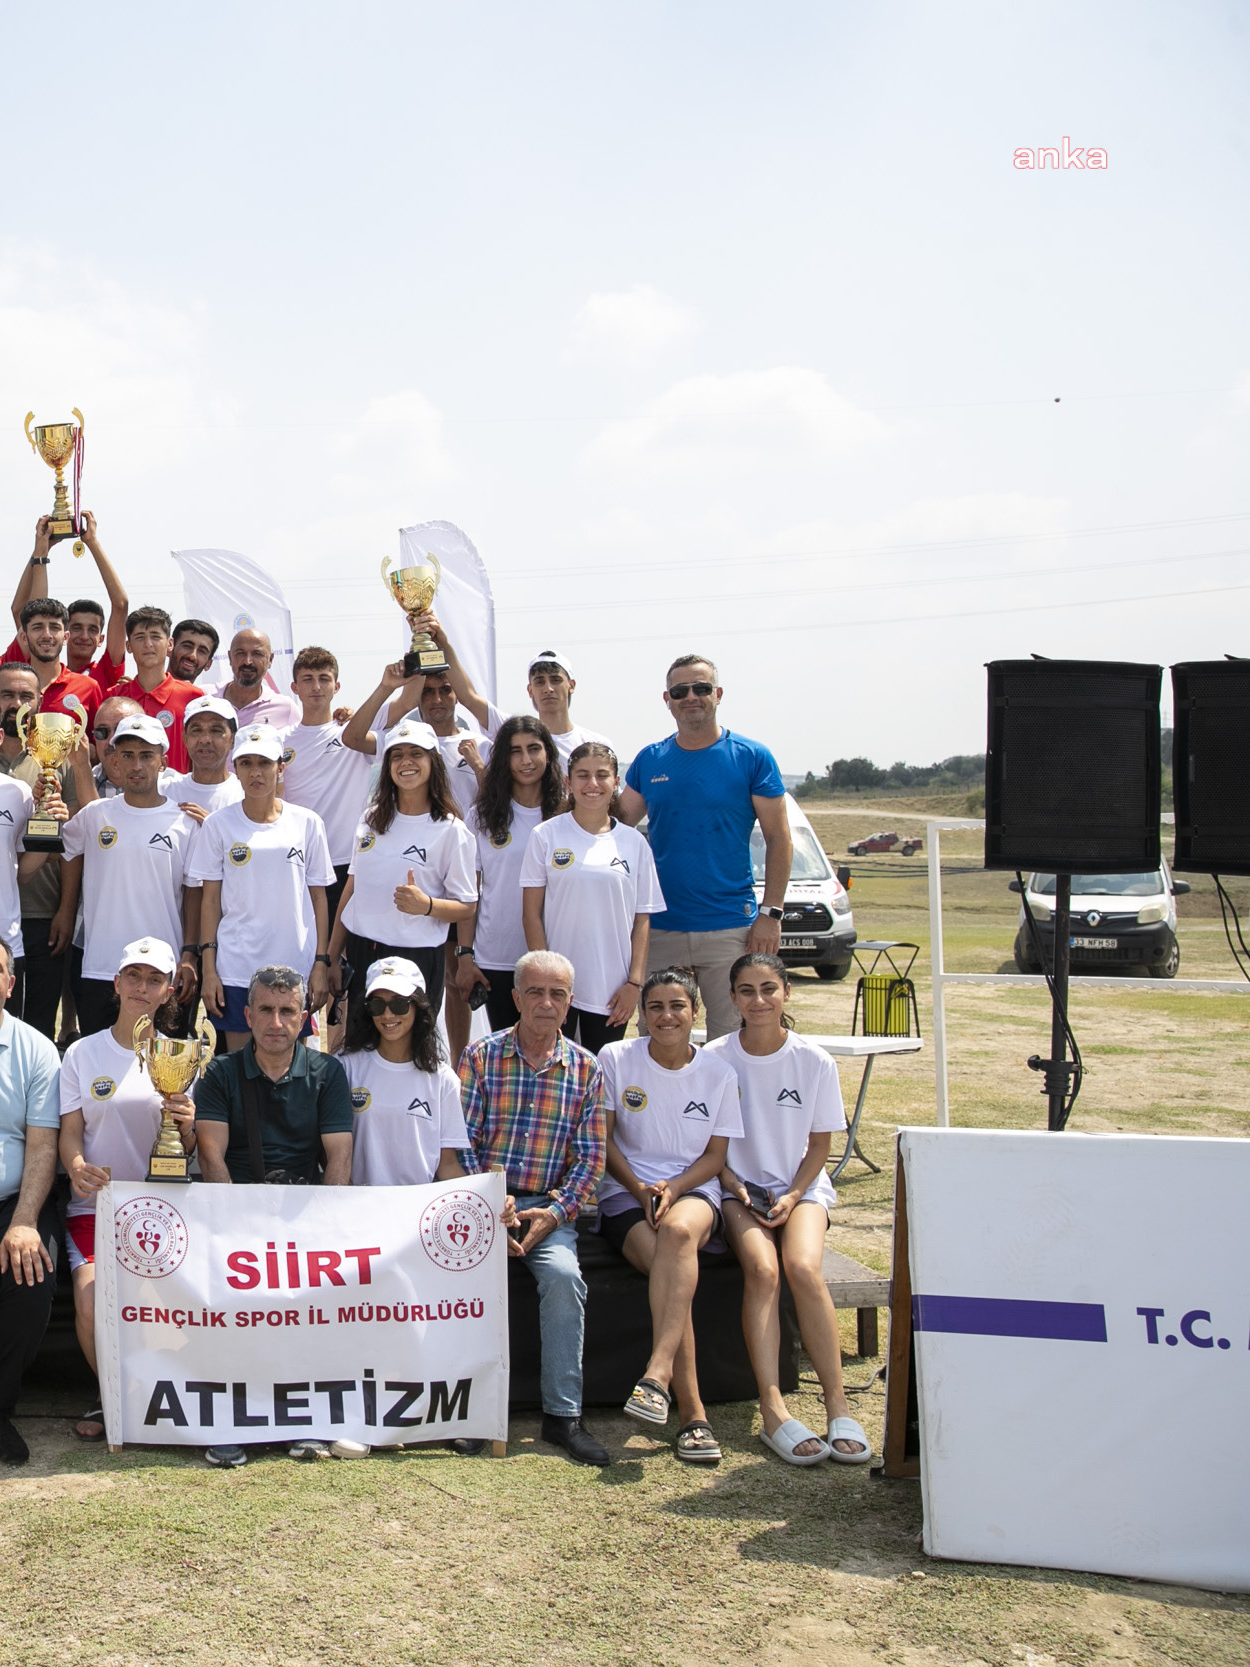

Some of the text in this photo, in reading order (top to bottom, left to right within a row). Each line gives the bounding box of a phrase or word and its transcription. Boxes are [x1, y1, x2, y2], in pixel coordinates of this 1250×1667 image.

[141, 1211, 162, 1220] GENÇLİK
[450, 1203, 471, 1211] GENÇLİK
[475, 1214, 483, 1230] SPOR
[226, 1242, 381, 1290] SİİRT
[121, 1299, 485, 1329] GENÇLİK SPOR İL MÜDÜRLÜĞÜ
[1136, 1307, 1231, 1350] T.C.
[144, 1369, 473, 1427] ATLETİZM
